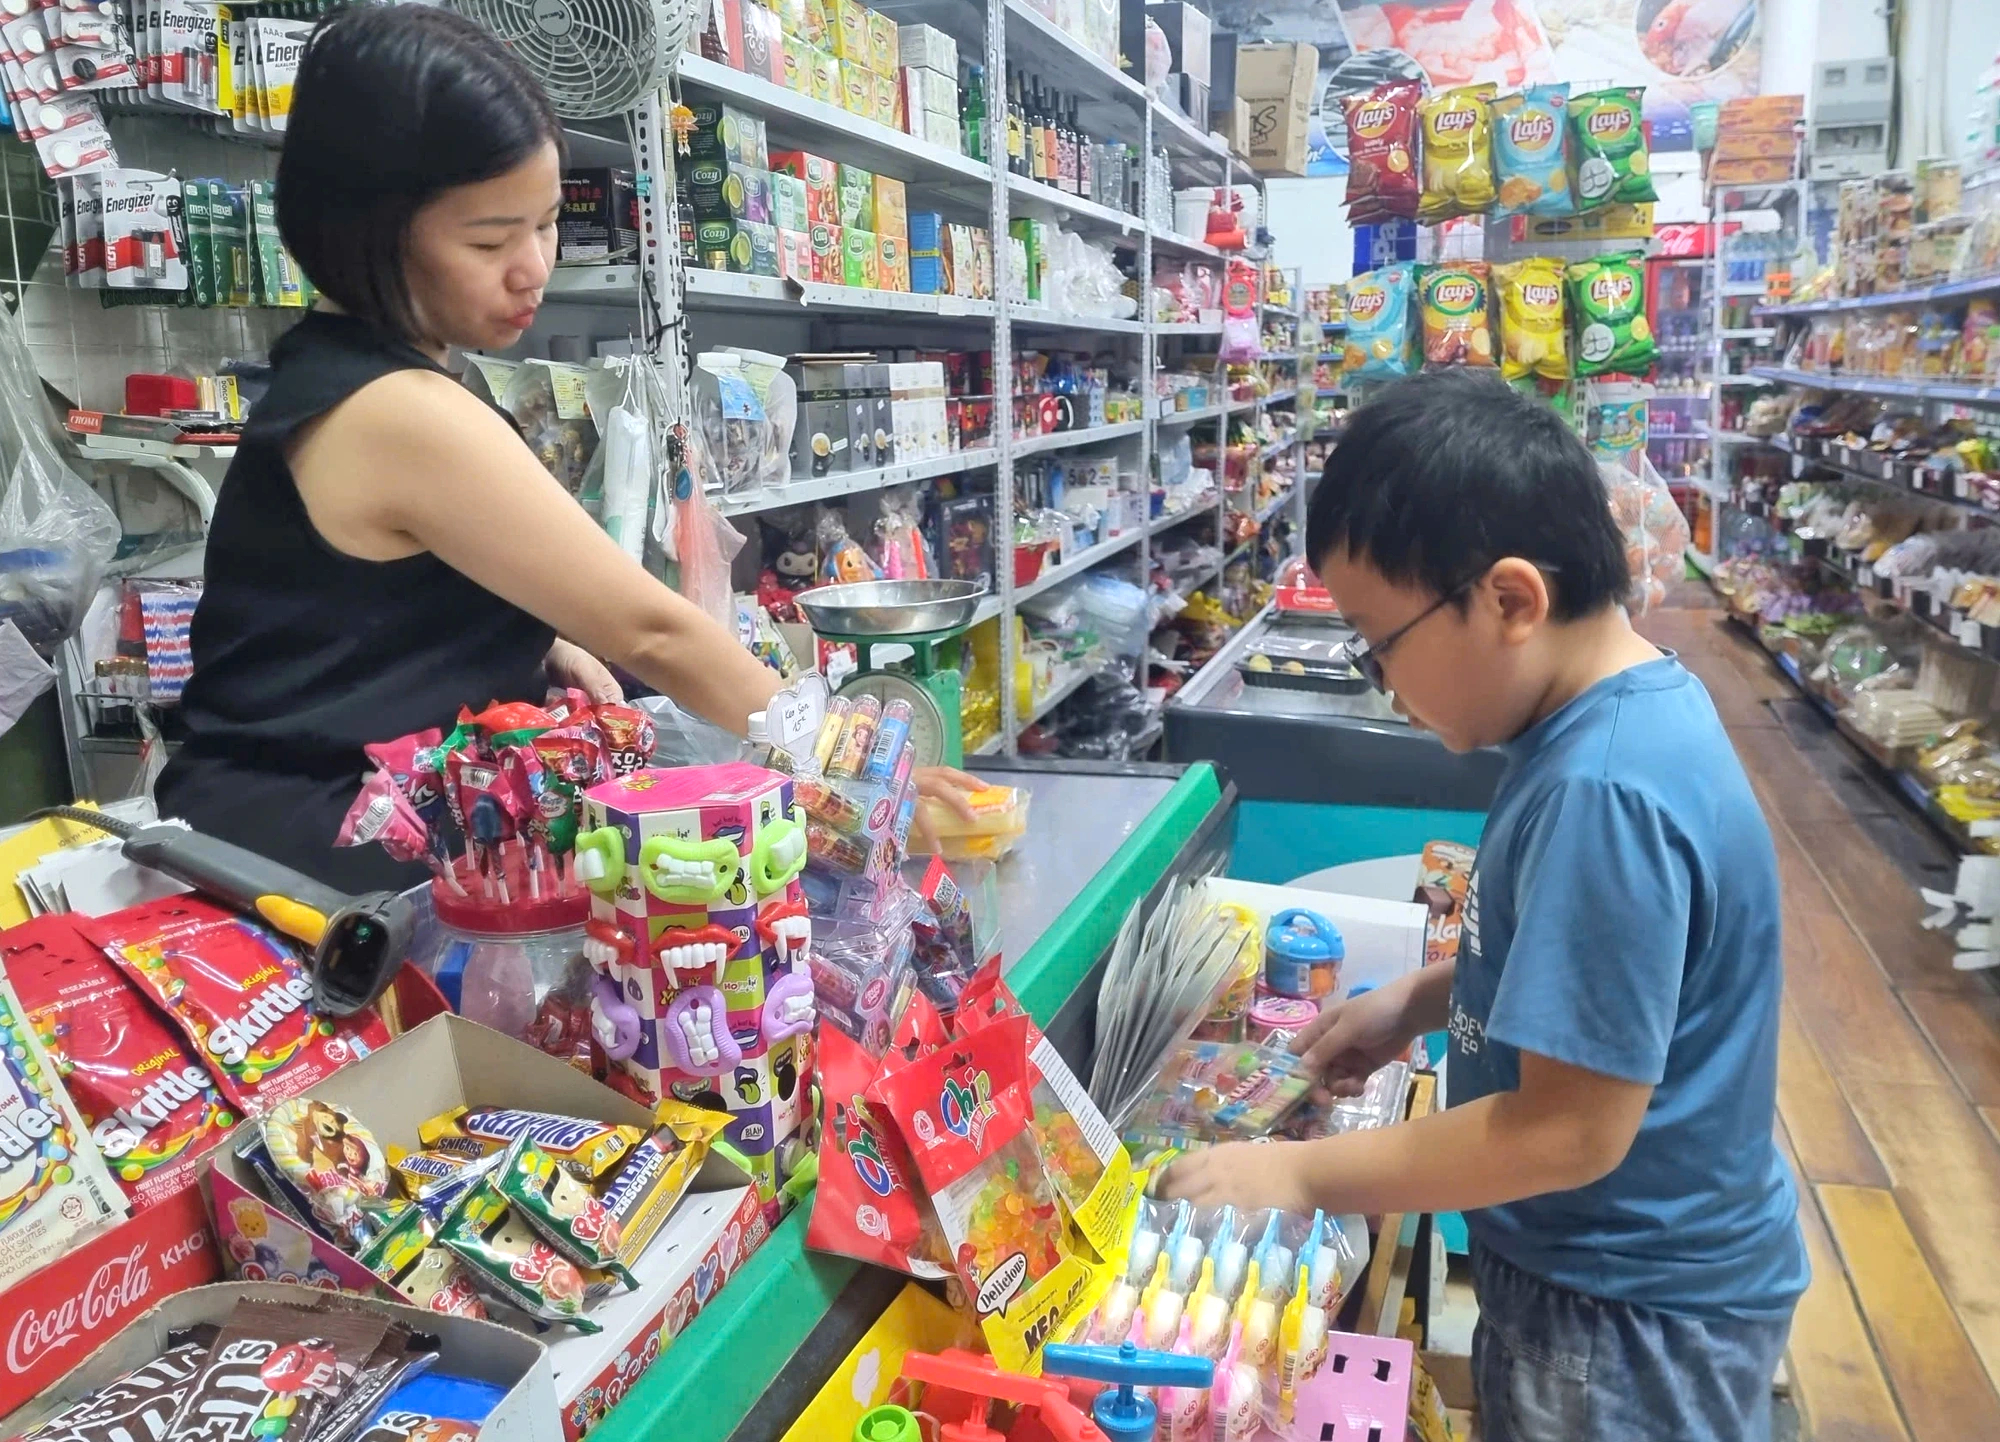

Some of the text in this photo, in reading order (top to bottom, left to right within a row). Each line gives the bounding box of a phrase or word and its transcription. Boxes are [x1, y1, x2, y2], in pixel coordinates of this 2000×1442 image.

[163, 10, 216, 32] Energizer
[696, 110, 713, 122] ozy
[1356, 106, 1394, 131] Lay's
[1437, 110, 1477, 132] Lay's
[1591, 109, 1631, 133] Lay's
[1513, 117, 1554, 142] Lay's
[695, 169, 718, 183] Cozy
[105, 193, 156, 214] Energizer
[213, 203, 233, 216] maxell
[703, 227, 726, 241] Cozy
[1438, 283, 1476, 303] Lay's
[1524, 284, 1559, 305] Lay's
[1594, 276, 1633, 301] Lay's
[1350, 291, 1385, 313] Lay's
[58, 976, 108, 996] RESEALABLE
[258, 1062, 310, 1092] FRUIT FLAVOUR CANDY
[92, 1065, 215, 1158] Skittle
[745, 1125, 762, 1137] BLAH
[400, 1157, 453, 1177] SNICKERS
[135, 1177, 154, 1193] FRUIT
[153, 1165, 182, 1186] FLAVOUR
[1, 1218, 43, 1246] FLAVOUR CANDY
[16, 1227, 47, 1248] SKITTLES
[979, 1256, 1026, 1310] Delicious
[6, 1240, 151, 1374] Coca-Cola
